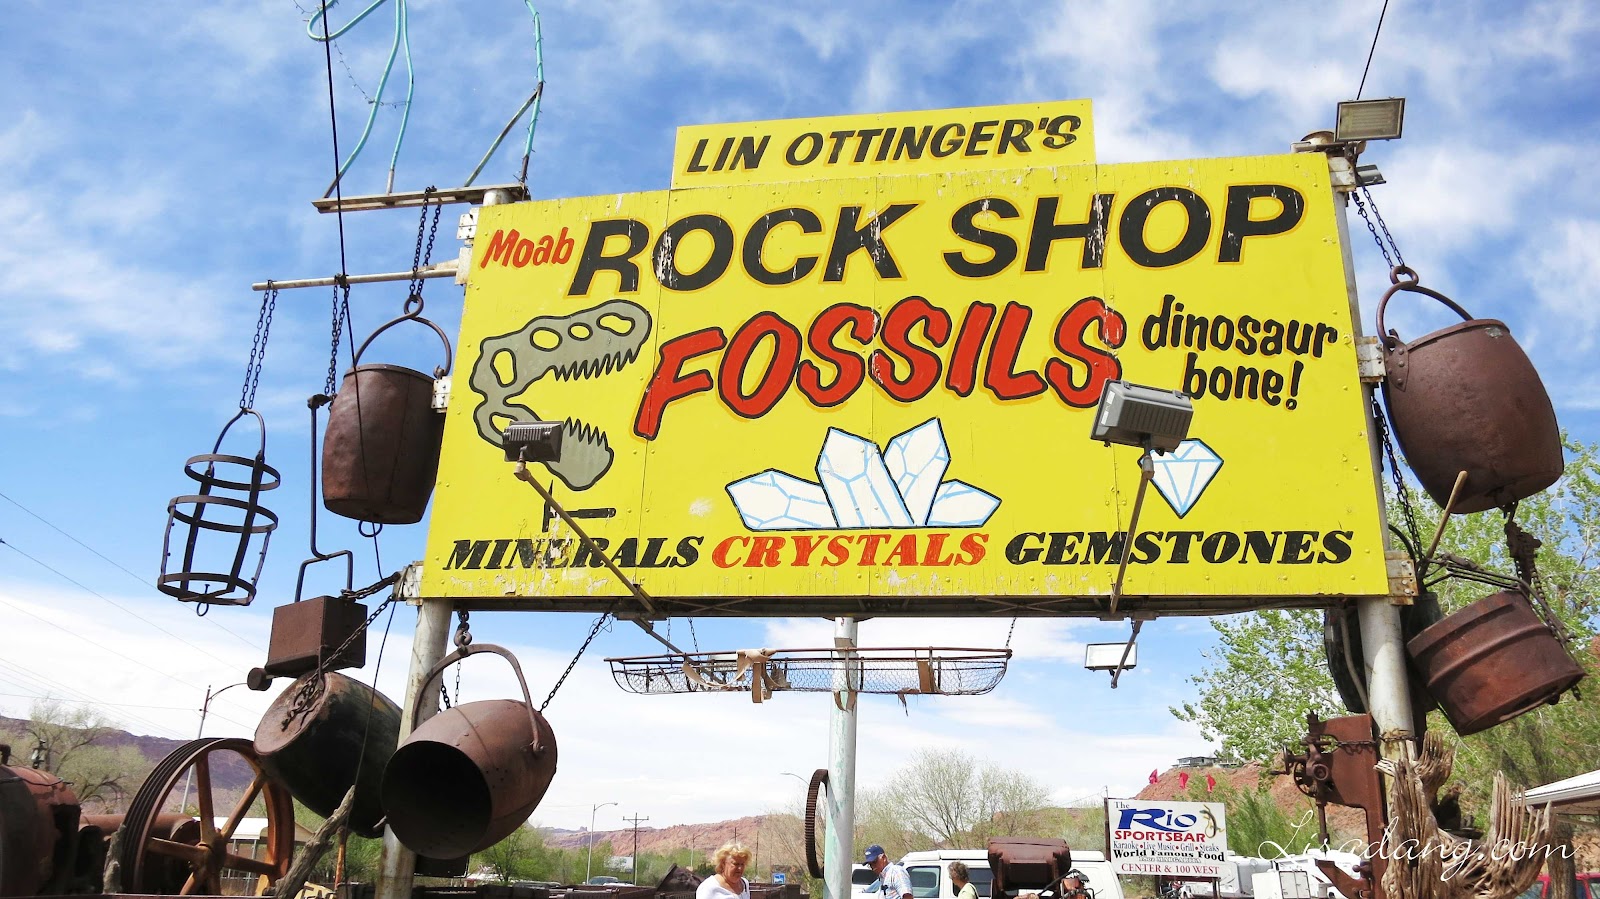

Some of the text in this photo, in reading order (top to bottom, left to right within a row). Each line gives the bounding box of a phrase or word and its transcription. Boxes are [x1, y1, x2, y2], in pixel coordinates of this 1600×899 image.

[686, 115, 1081, 173] LIN OTTINGER'S
[480, 185, 1305, 296] Moab ROCK SHOP
[1142, 294, 1338, 358] dinosaur
[633, 296, 1127, 440] FOSSILS
[1183, 352, 1304, 410] bone!
[443, 530, 1354, 570] MINERALS CRYSTALS GEMSTONES
[1114, 801, 1130, 809] The
[1117, 808, 1198, 833] Rio
[1113, 840, 1220, 852] Karaoke Live Music Grill Steaks
[1114, 830, 1206, 843] SPORTSBAR
[1113, 849, 1147, 859] World
[1151, 850, 1194, 858] Famous
[1198, 851, 1226, 862] Food
[1121, 862, 1220, 875] CENTER & 100 WEST
